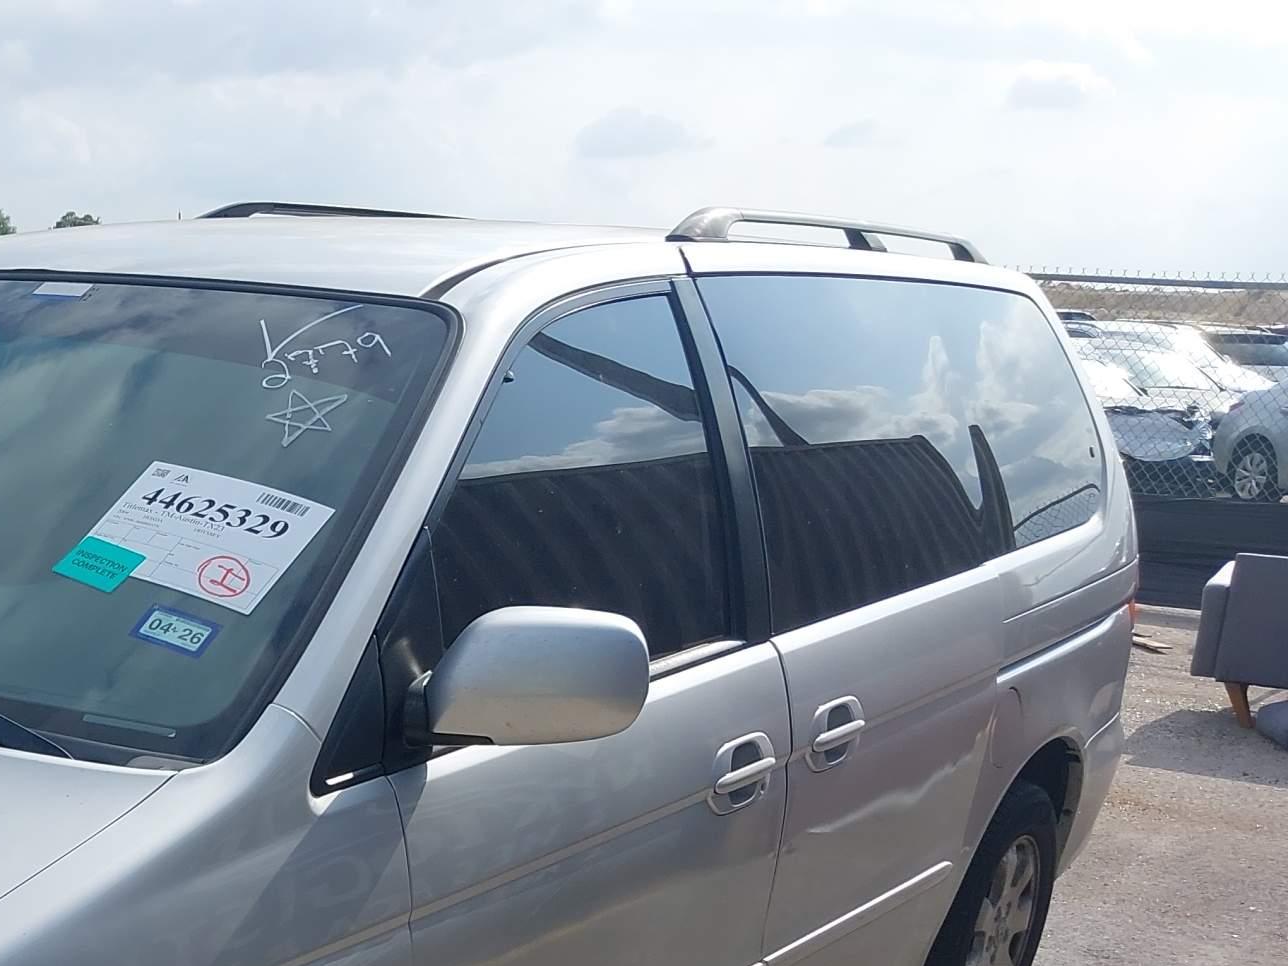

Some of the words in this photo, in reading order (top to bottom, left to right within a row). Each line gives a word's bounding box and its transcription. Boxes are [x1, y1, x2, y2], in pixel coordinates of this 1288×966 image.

[122, 501, 153, 515] Titlemax
[142, 487, 290, 539] 44625329
[72, 558, 119, 580] COMPLETE
[75, 549, 128, 573] INSPECTION
[148, 618, 171, 635] 04
[177, 628, 205, 645] 26
